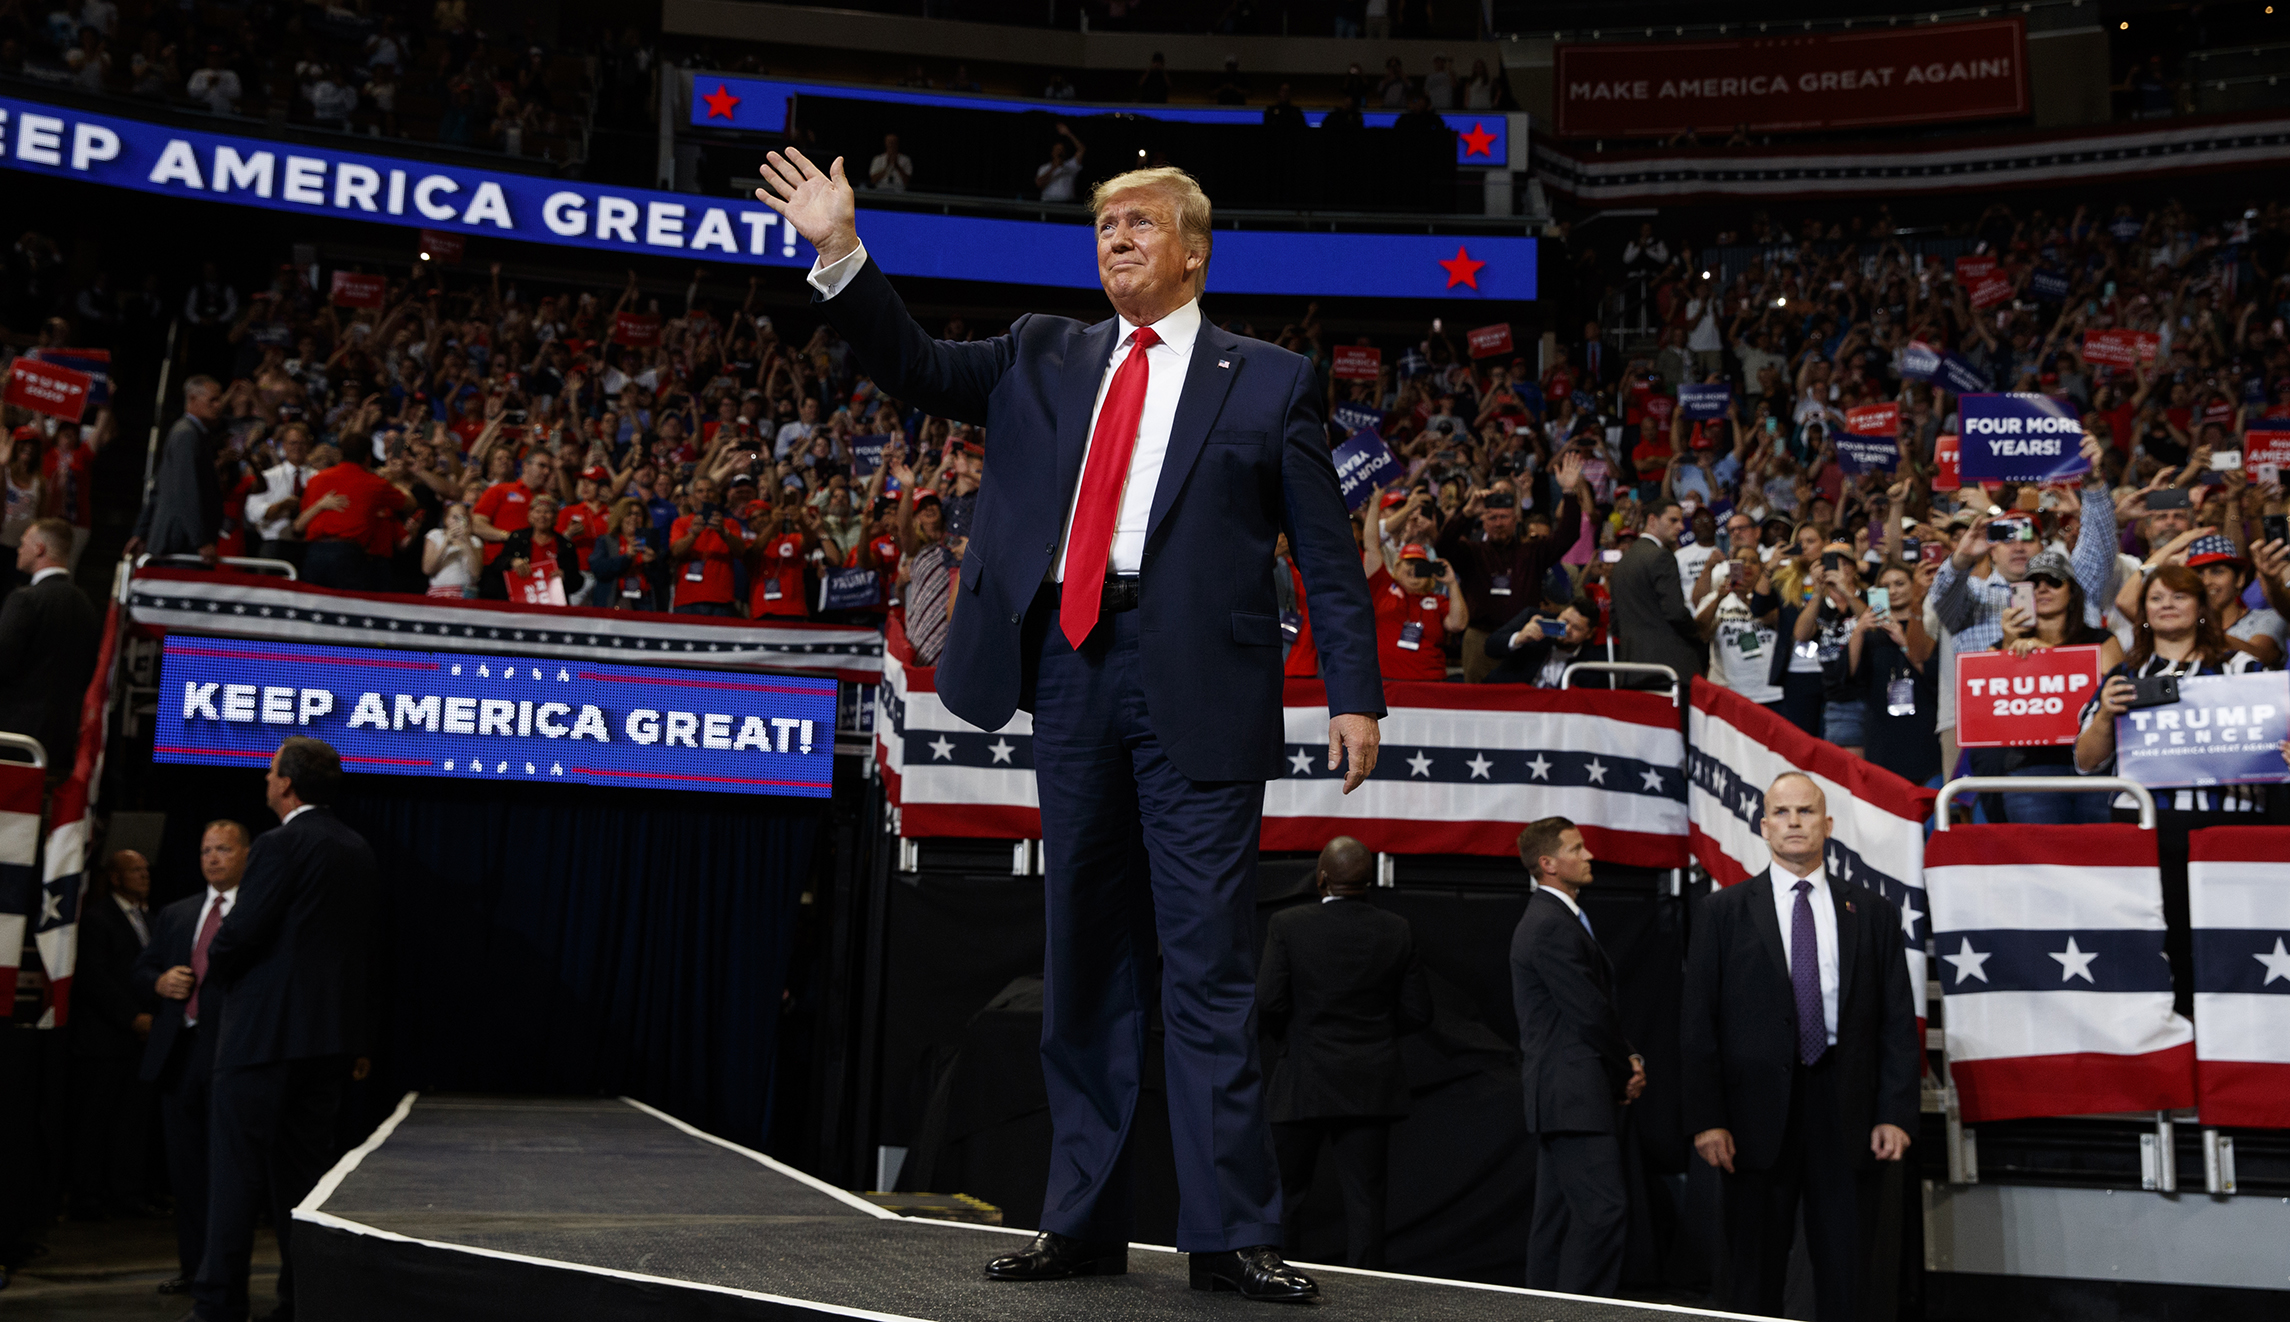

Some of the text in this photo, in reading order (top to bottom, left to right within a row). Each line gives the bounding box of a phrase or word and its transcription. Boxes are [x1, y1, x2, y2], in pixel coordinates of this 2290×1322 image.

[1569, 56, 2010, 101] MAKE AMERICA GREAT AGAIN!
[0, 108, 797, 258] EP AMERICA GREAT!
[1965, 416, 2083, 435] FOUR MORE
[1988, 438, 2063, 457] YEARS!
[1336, 450, 1370, 478] YEAR
[1340, 451, 1392, 496] FOUR MO
[1966, 673, 2090, 697] TRUMP
[183, 681, 334, 726] KEEP
[346, 692, 611, 742] AMERICA
[625, 709, 814, 755] GREAT!
[1992, 696, 2064, 716] 2020
[2129, 704, 2276, 731] TRUMP
[2144, 726, 2264, 746] PENCE
